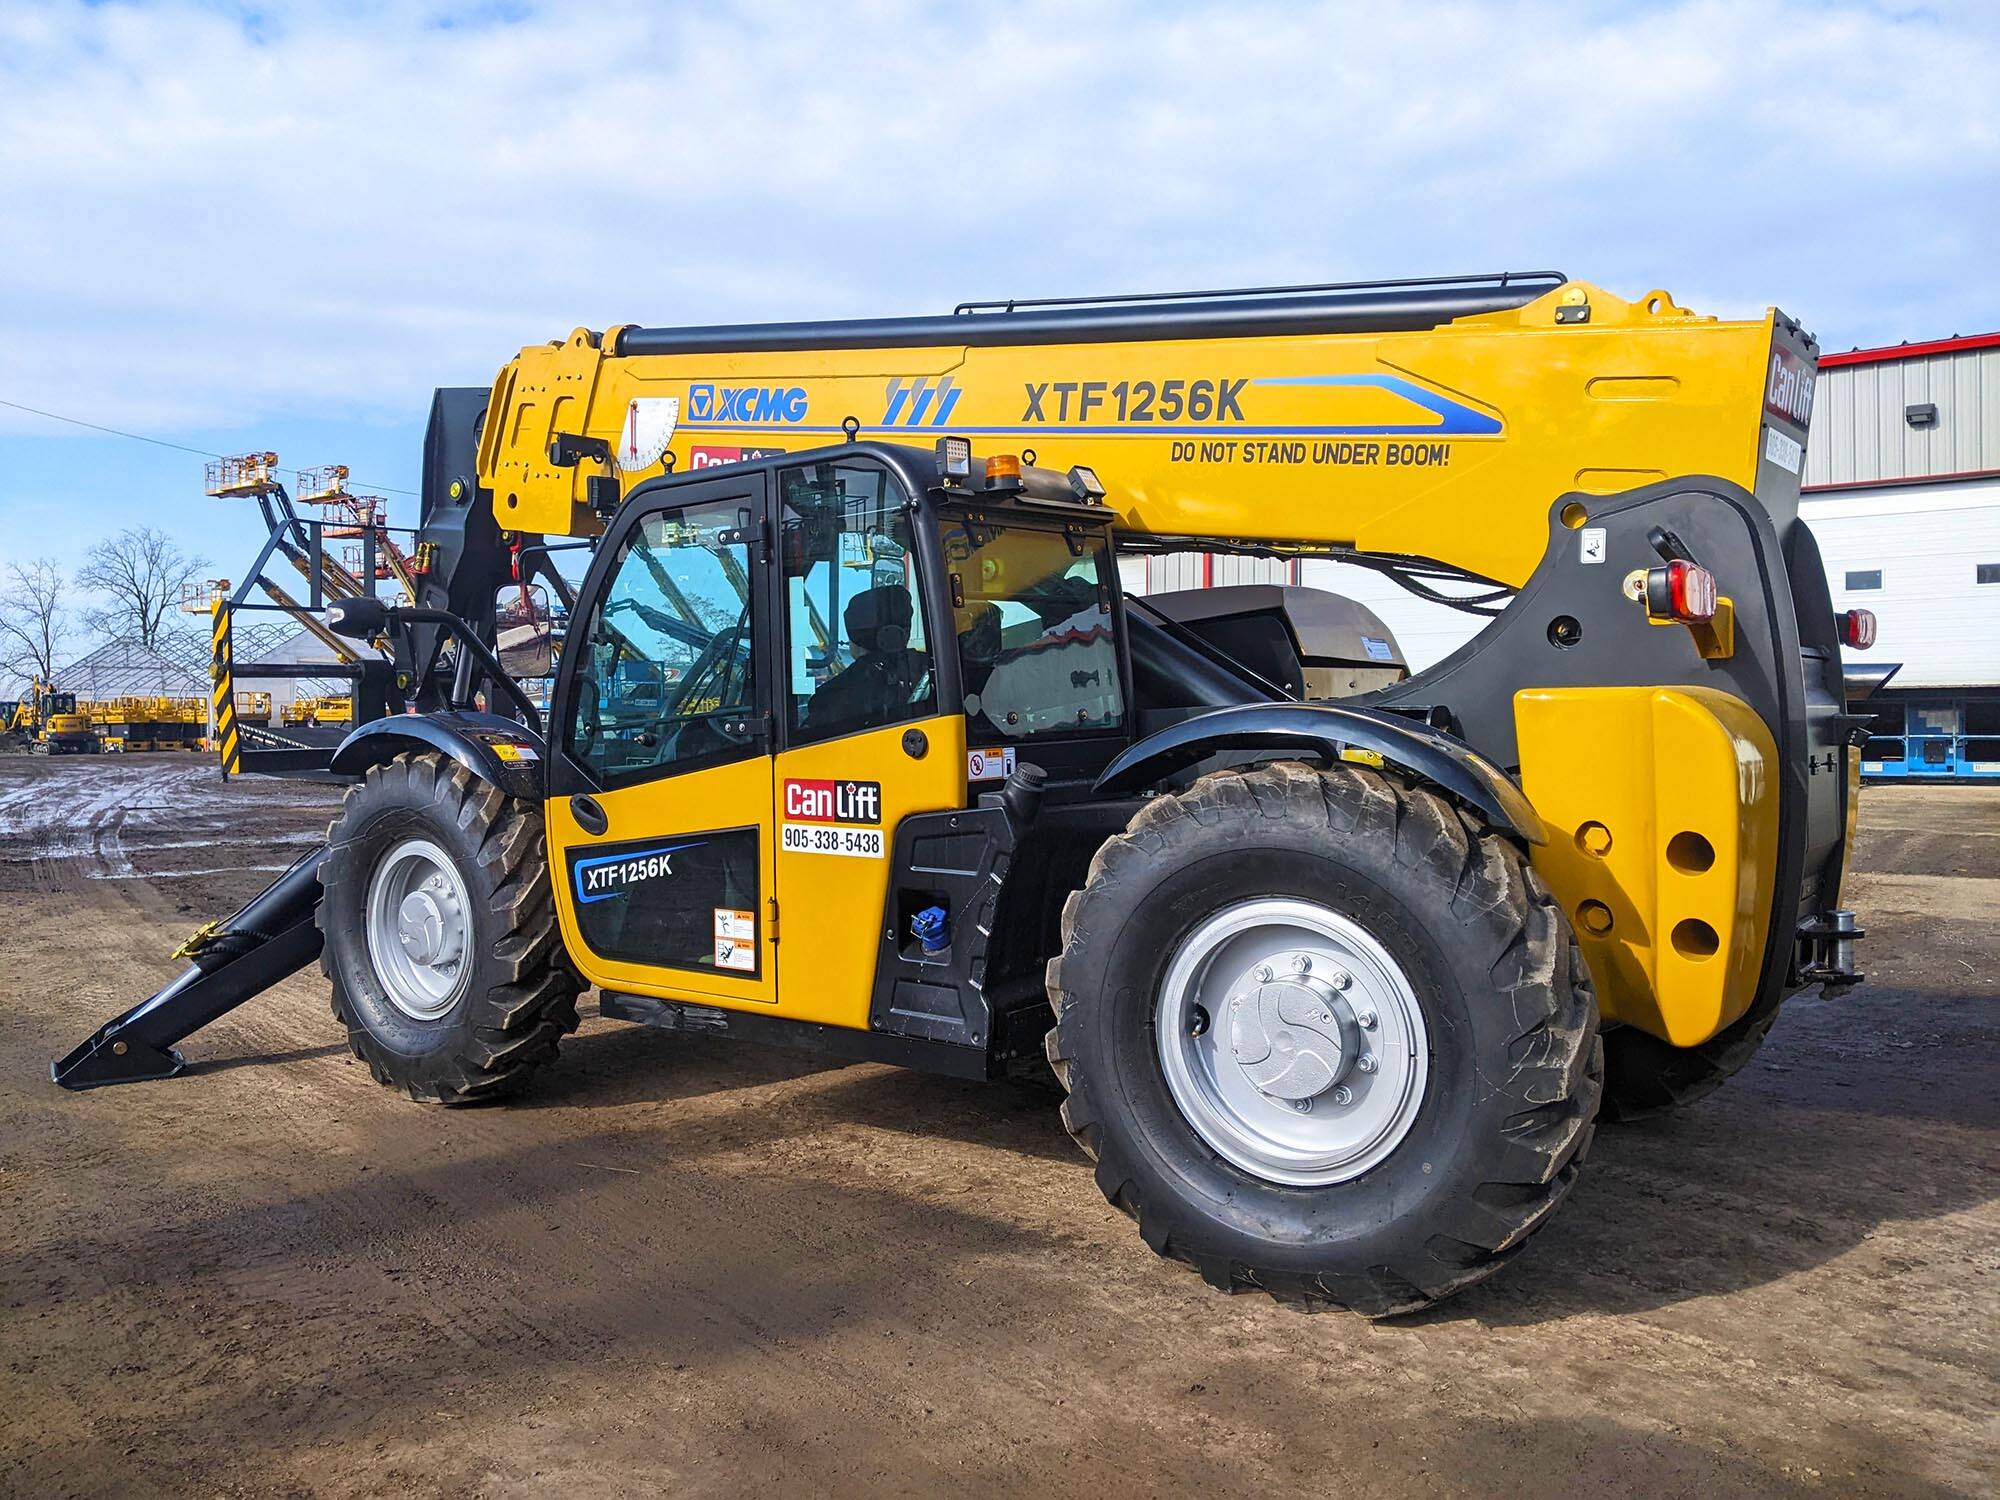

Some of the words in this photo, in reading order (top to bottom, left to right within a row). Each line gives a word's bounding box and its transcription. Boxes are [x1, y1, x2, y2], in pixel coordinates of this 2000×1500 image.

[714, 387, 808, 423] XCMG
[1022, 378, 1249, 422] XTF1256K
[1171, 441, 1195, 463] DO
[1200, 441, 1237, 463] NOT
[1242, 441, 1306, 465] STAND
[1313, 442, 1380, 466] UNDER
[1386, 443, 1450, 467] BOOM!
[785, 828, 880, 854] 905-338-5438
[587, 855, 673, 890] XTF1256K
